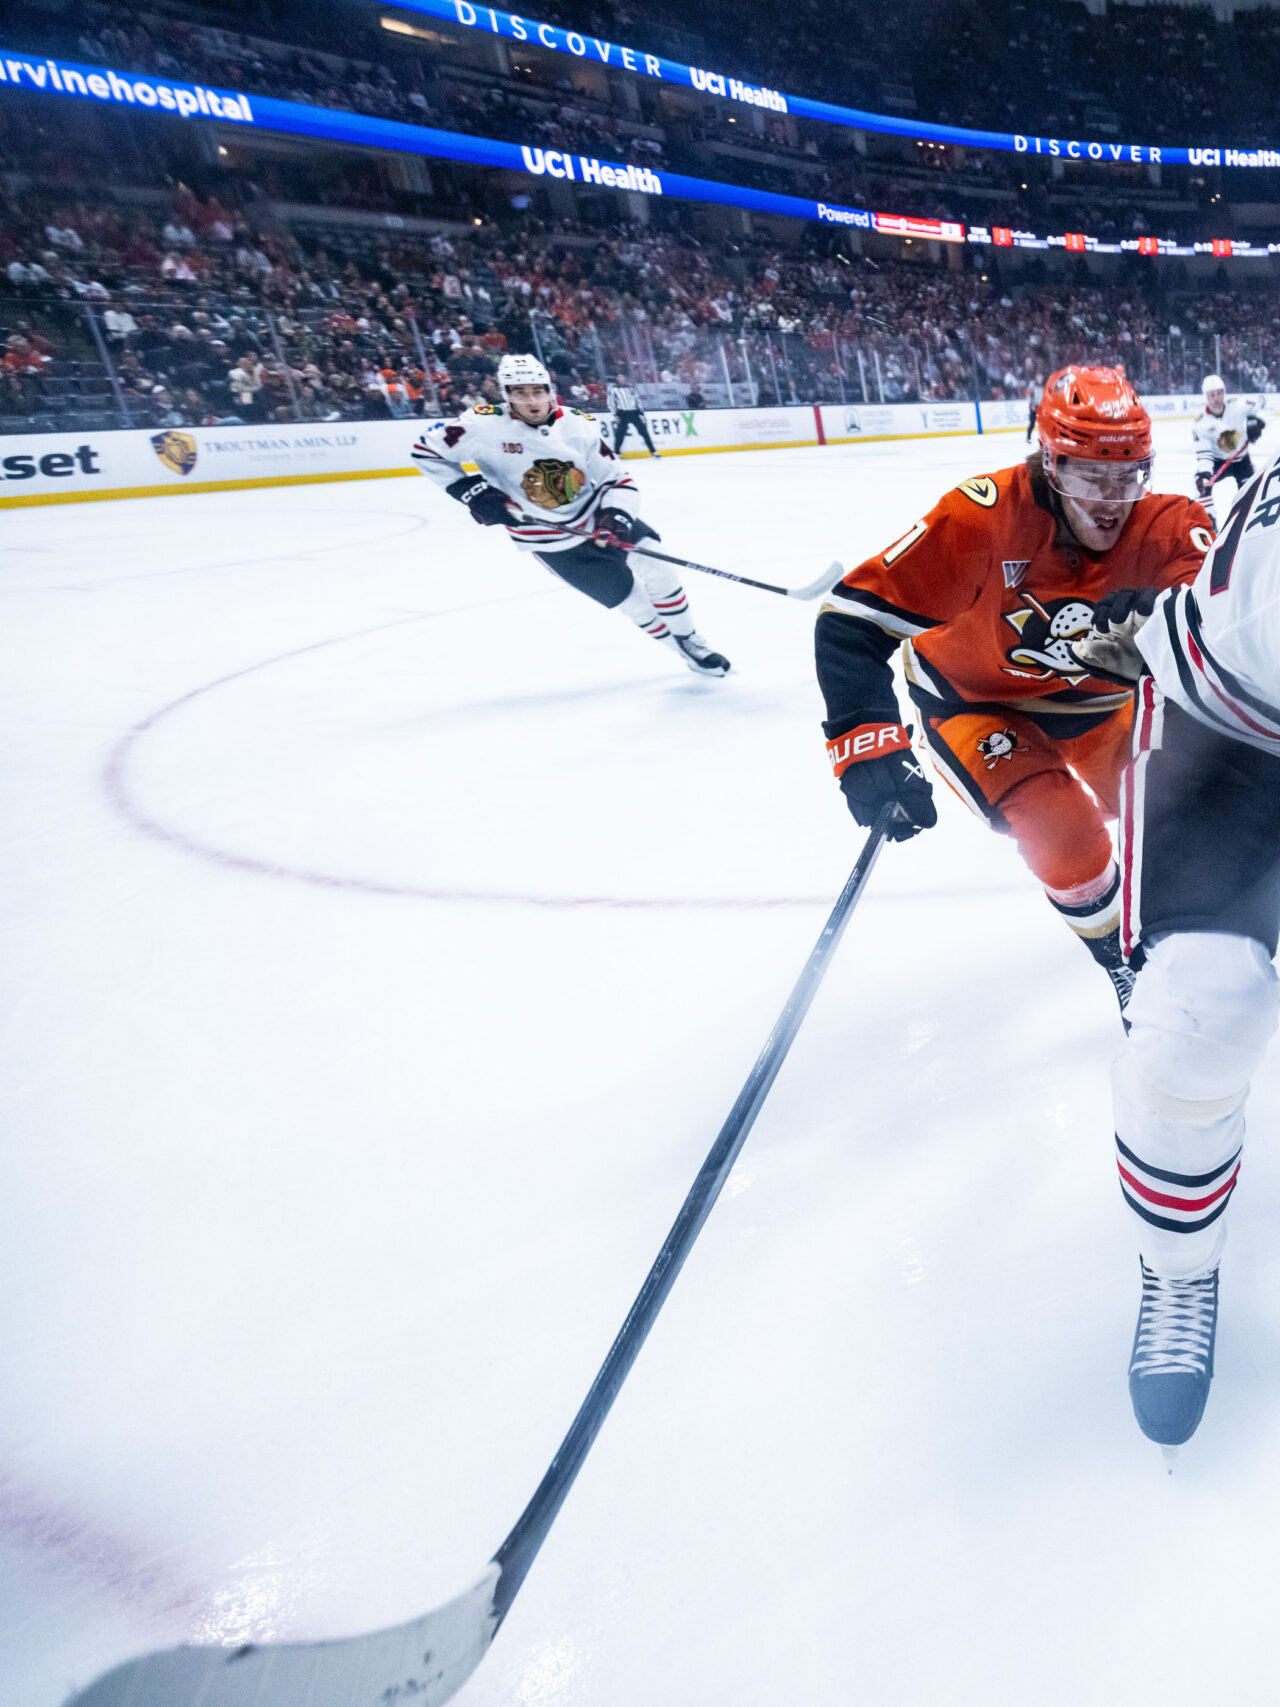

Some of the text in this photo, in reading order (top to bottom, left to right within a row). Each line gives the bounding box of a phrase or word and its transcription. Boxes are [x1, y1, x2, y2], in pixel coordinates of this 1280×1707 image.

[456, 0, 788, 113] DISCOVER UCI Health
[1014, 134, 1162, 163] DISCOVER
[1188, 148, 1220, 166] UCI
[521, 145, 663, 195] UCI Health
[817, 203, 870, 229] Powered
[204, 439, 291, 453] TROUTMAN
[336, 434, 359, 447] LLP
[0, 444, 100, 481] set
[828, 725, 900, 768] AUER
